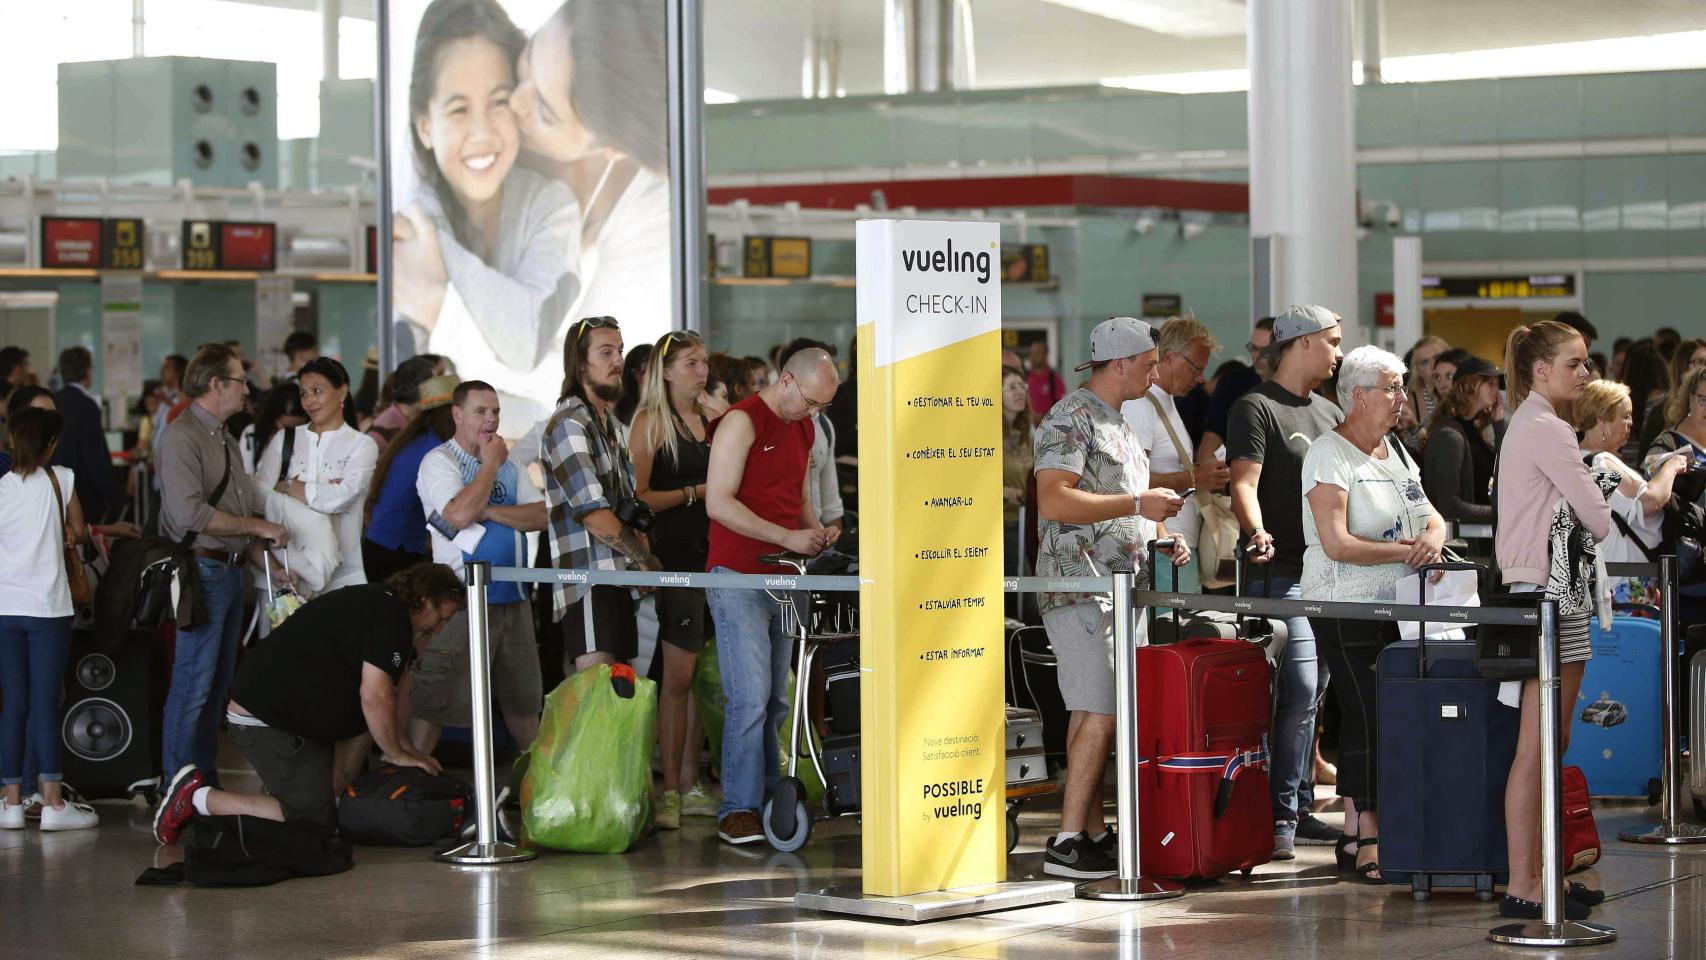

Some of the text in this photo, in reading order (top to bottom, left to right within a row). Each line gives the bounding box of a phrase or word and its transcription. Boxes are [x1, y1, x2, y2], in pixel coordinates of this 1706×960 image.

[902, 238, 991, 284] vueling
[906, 294, 987, 314] CHECK-IN
[955, 396, 964, 407] EL
[966, 396, 980, 407] TEU
[981, 397, 994, 407] VOL
[948, 447, 957, 458] EL
[959, 447, 972, 458] SEU
[974, 447, 996, 458] ESTAT
[930, 496, 973, 508] AVANÇAR-LO
[953, 548, 962, 559] EL
[557, 570, 588, 584] vueling
[659, 572, 691, 586] vueling
[764, 575, 797, 589] vueling
[963, 596, 985, 608] TEMPS
[926, 649, 948, 661] ESTAR
[923, 736, 943, 747] Nova
[923, 778, 983, 800] POSSIBLE
[922, 798, 982, 823] by vueling
